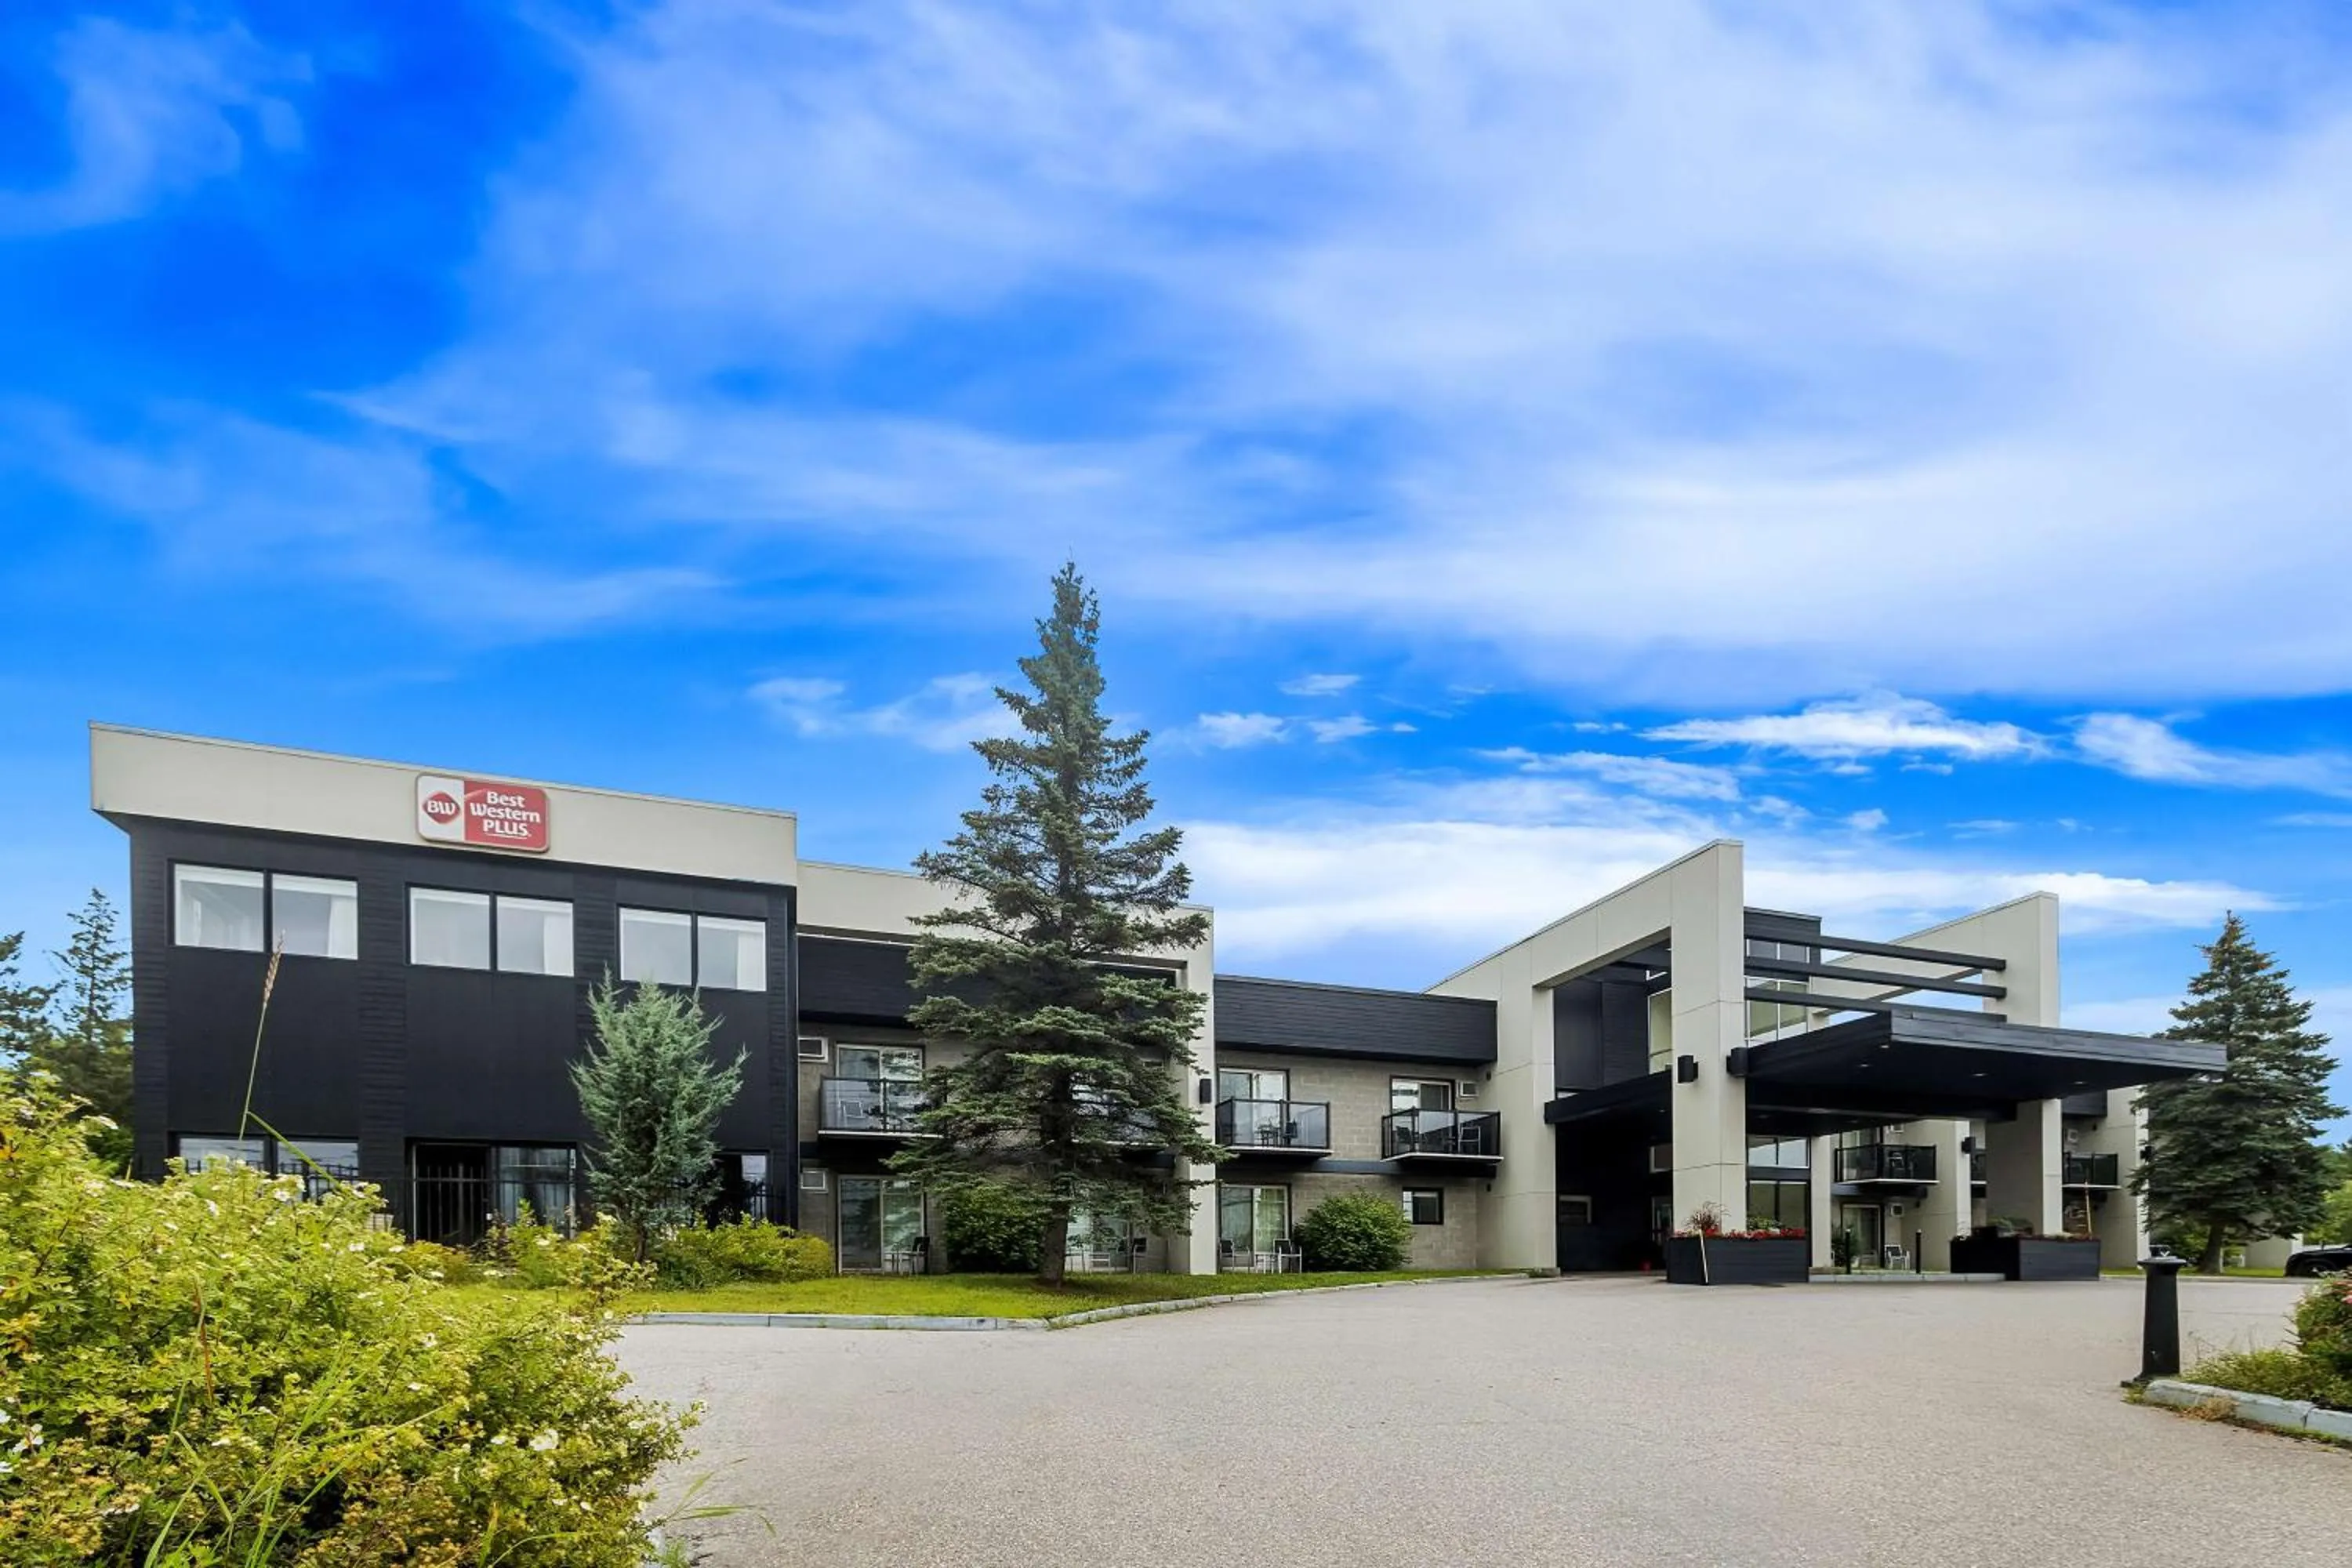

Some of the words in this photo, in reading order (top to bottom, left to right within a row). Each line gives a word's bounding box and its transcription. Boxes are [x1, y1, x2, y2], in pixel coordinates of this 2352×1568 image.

[427, 800, 456, 815] BW
[486, 791, 526, 808] Best
[470, 802, 540, 823] Western
[483, 819, 528, 837] PLUS
